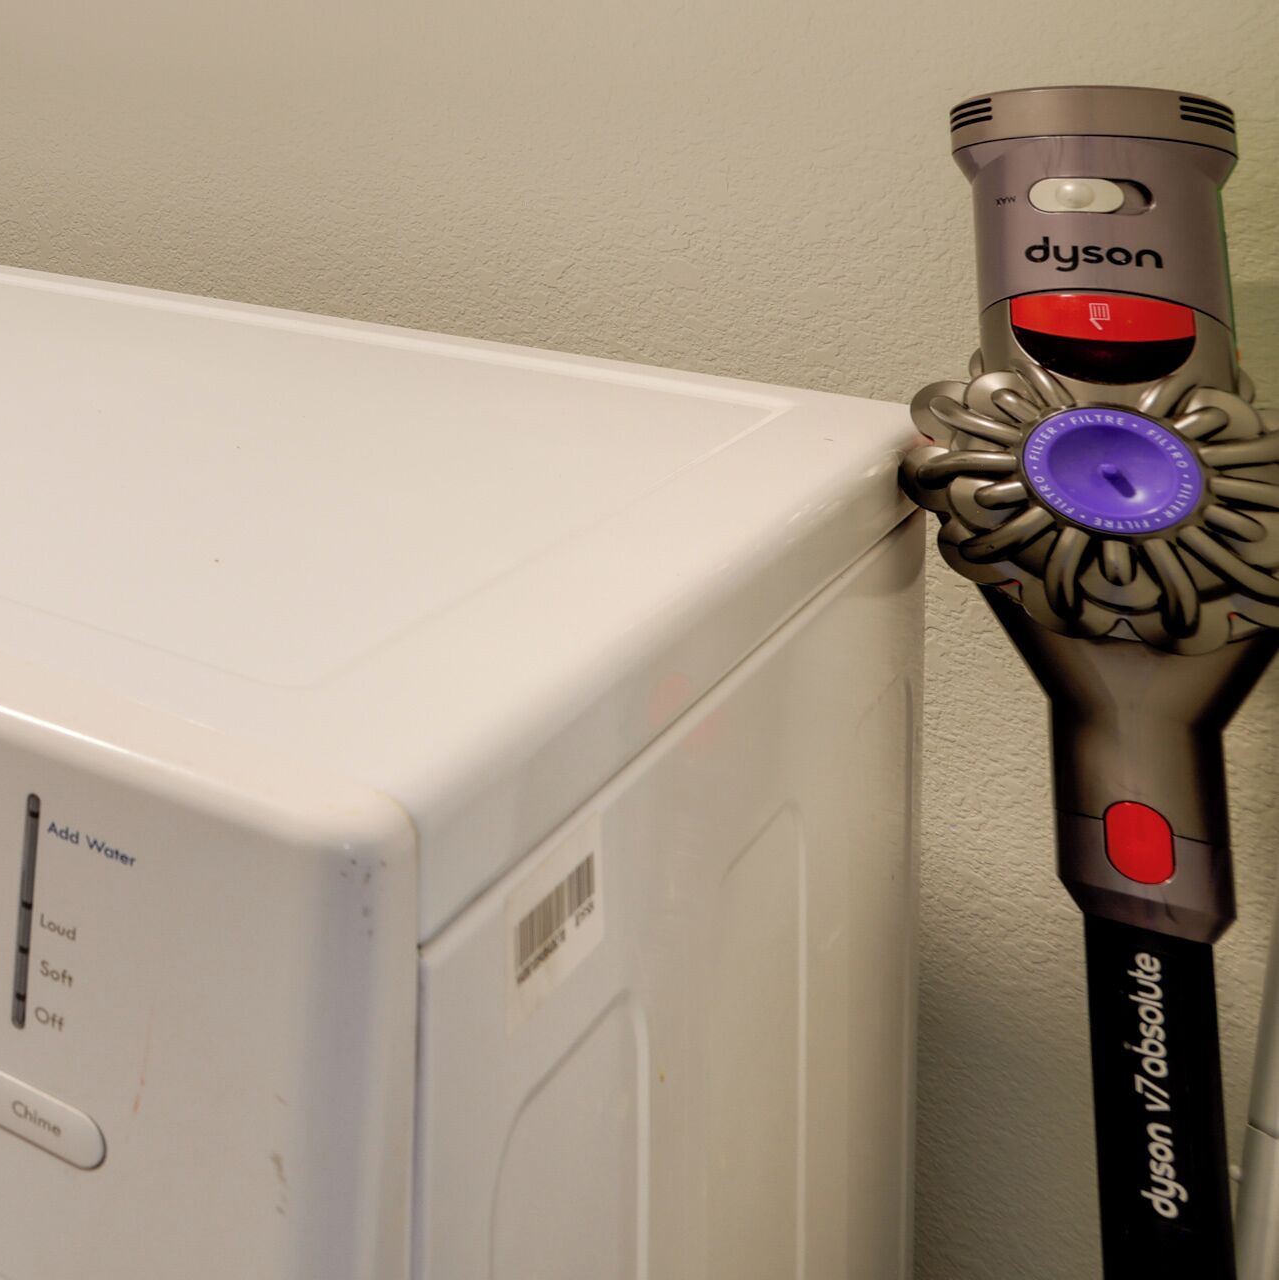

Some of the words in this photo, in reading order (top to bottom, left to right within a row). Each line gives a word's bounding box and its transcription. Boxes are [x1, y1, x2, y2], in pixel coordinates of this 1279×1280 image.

[1025, 236, 1164, 272] dyson
[1069, 414, 1125, 426] FILTRE
[1029, 426, 1057, 461] FILTER
[1146, 428, 1189, 469] FILTRO
[1033, 475, 1075, 515] FILTRO
[47, 821, 80, 846] Add
[84, 834, 136, 868] Water
[39, 914, 77, 943] Loud
[40, 960, 74, 989] Soft
[34, 1006, 65, 1033] Off
[12, 1100, 63, 1138] Chime
[1140, 1122, 1189, 1219] dyson
